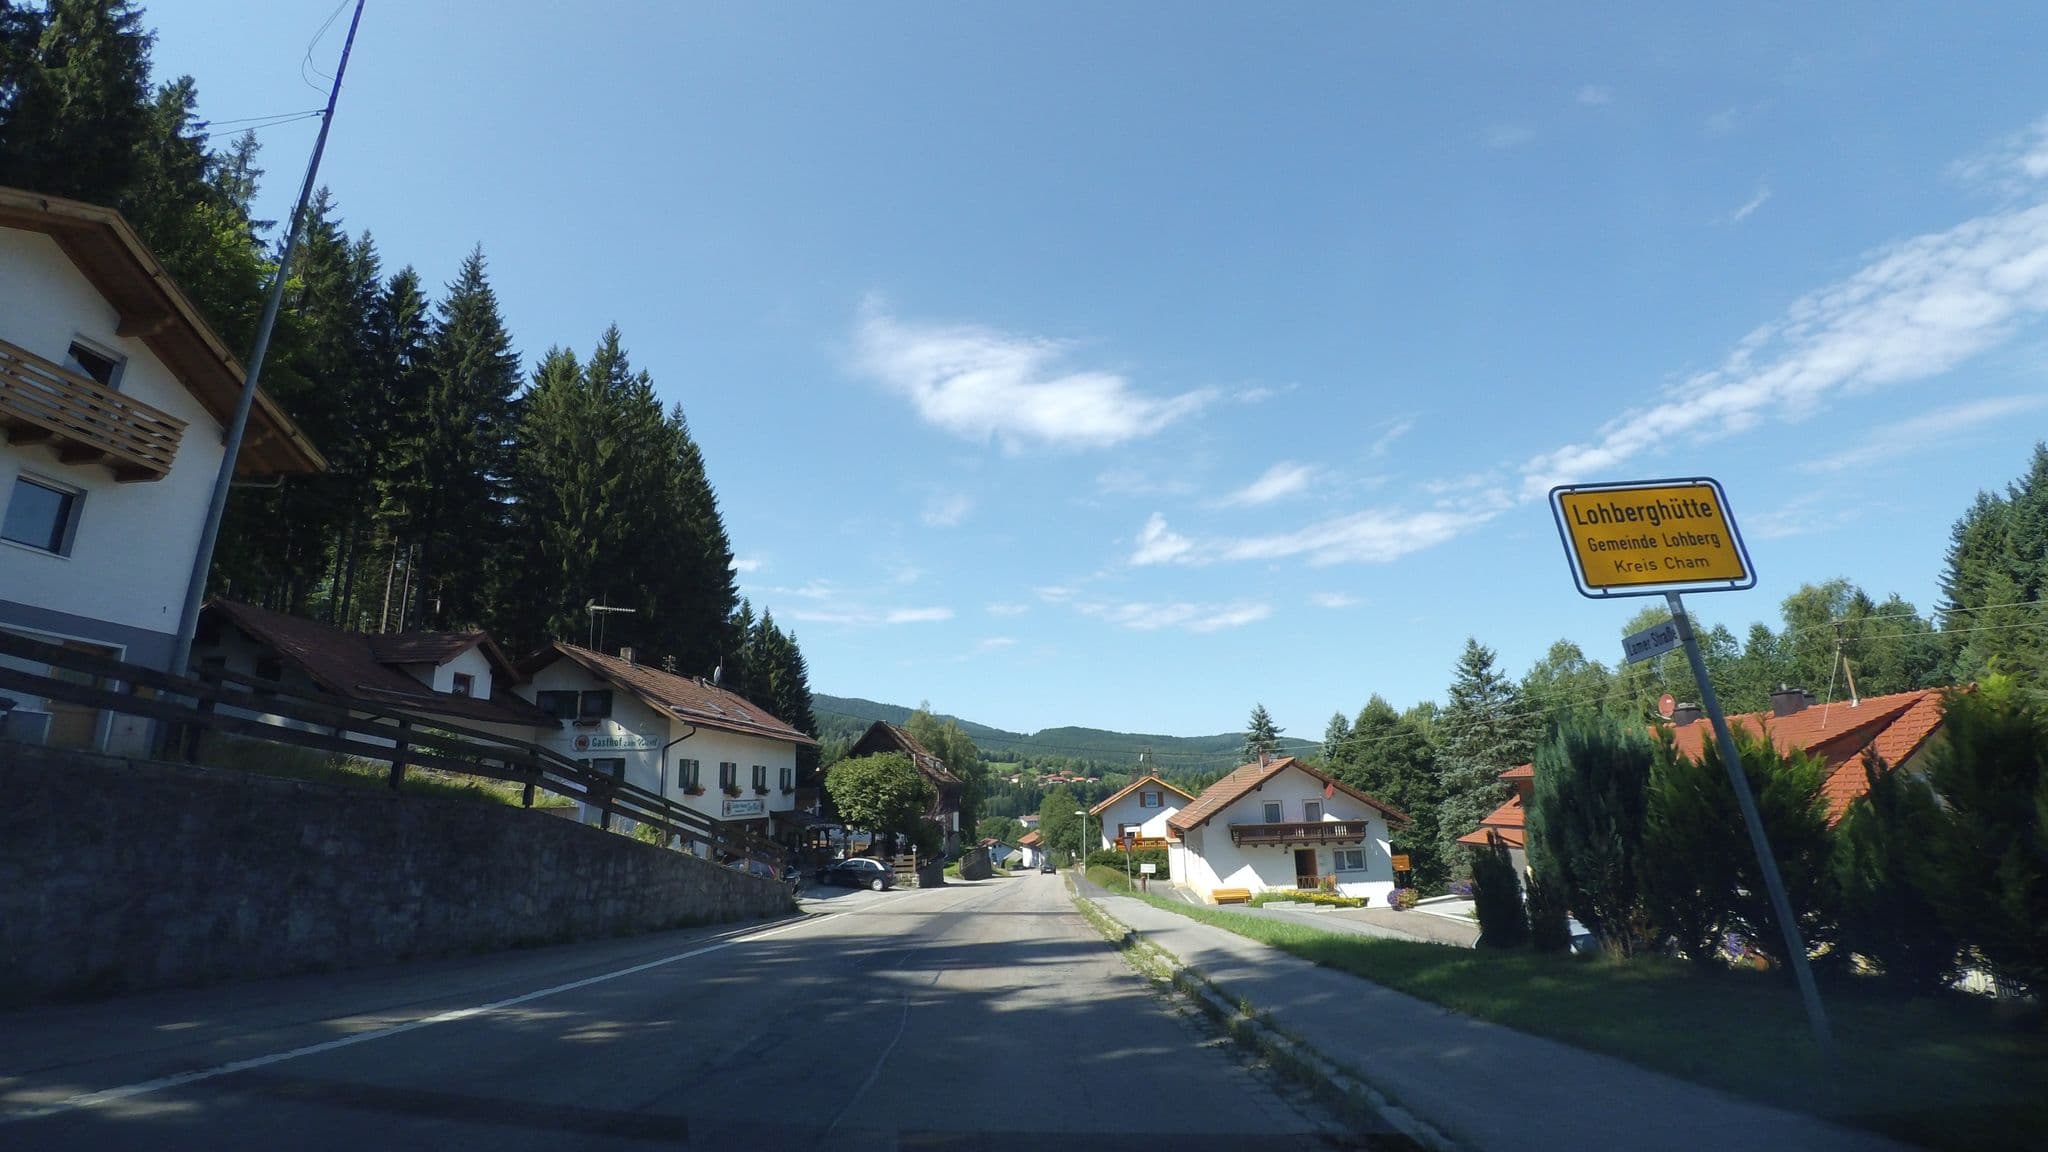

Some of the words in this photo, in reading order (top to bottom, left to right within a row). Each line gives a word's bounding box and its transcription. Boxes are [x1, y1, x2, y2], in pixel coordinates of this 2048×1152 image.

[1572, 498, 1713, 527] Lohberghütte
[1588, 534, 1658, 552] Gemeinde
[1662, 531, 1721, 548] Lohberg
[1614, 558, 1658, 573] Kreis
[1664, 556, 1710, 570] Cham
[591, 737, 623, 747] Gasthof
